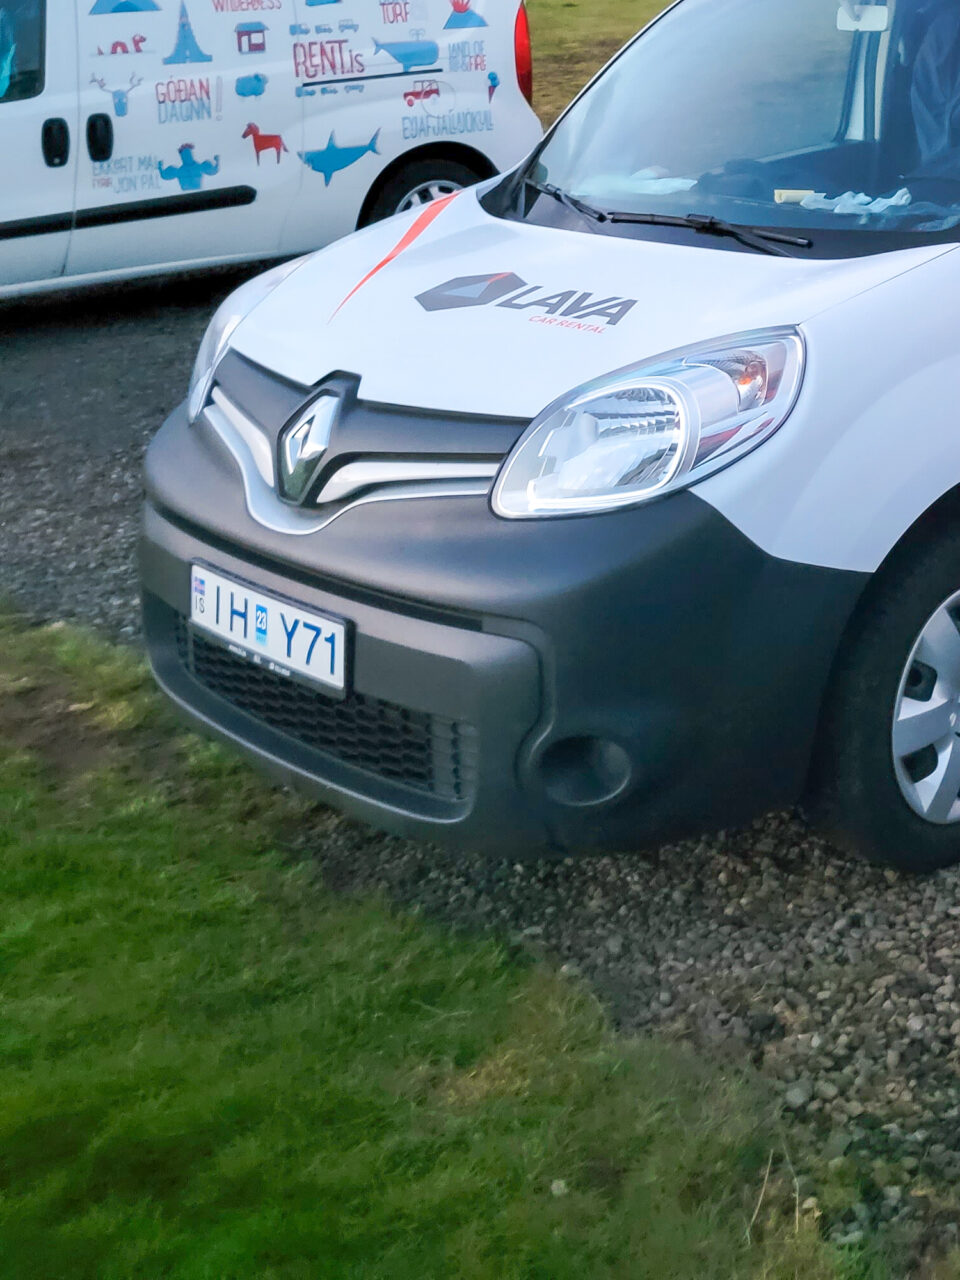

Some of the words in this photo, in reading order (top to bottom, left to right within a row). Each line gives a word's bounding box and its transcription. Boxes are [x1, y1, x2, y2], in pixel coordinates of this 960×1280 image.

[379, 1, 410, 24] TURF
[495, 286, 639, 326] LAVA
[528, 315, 558, 326] CAR
[559, 319, 607, 334] RENTAL
[194, 594, 205, 614] IS
